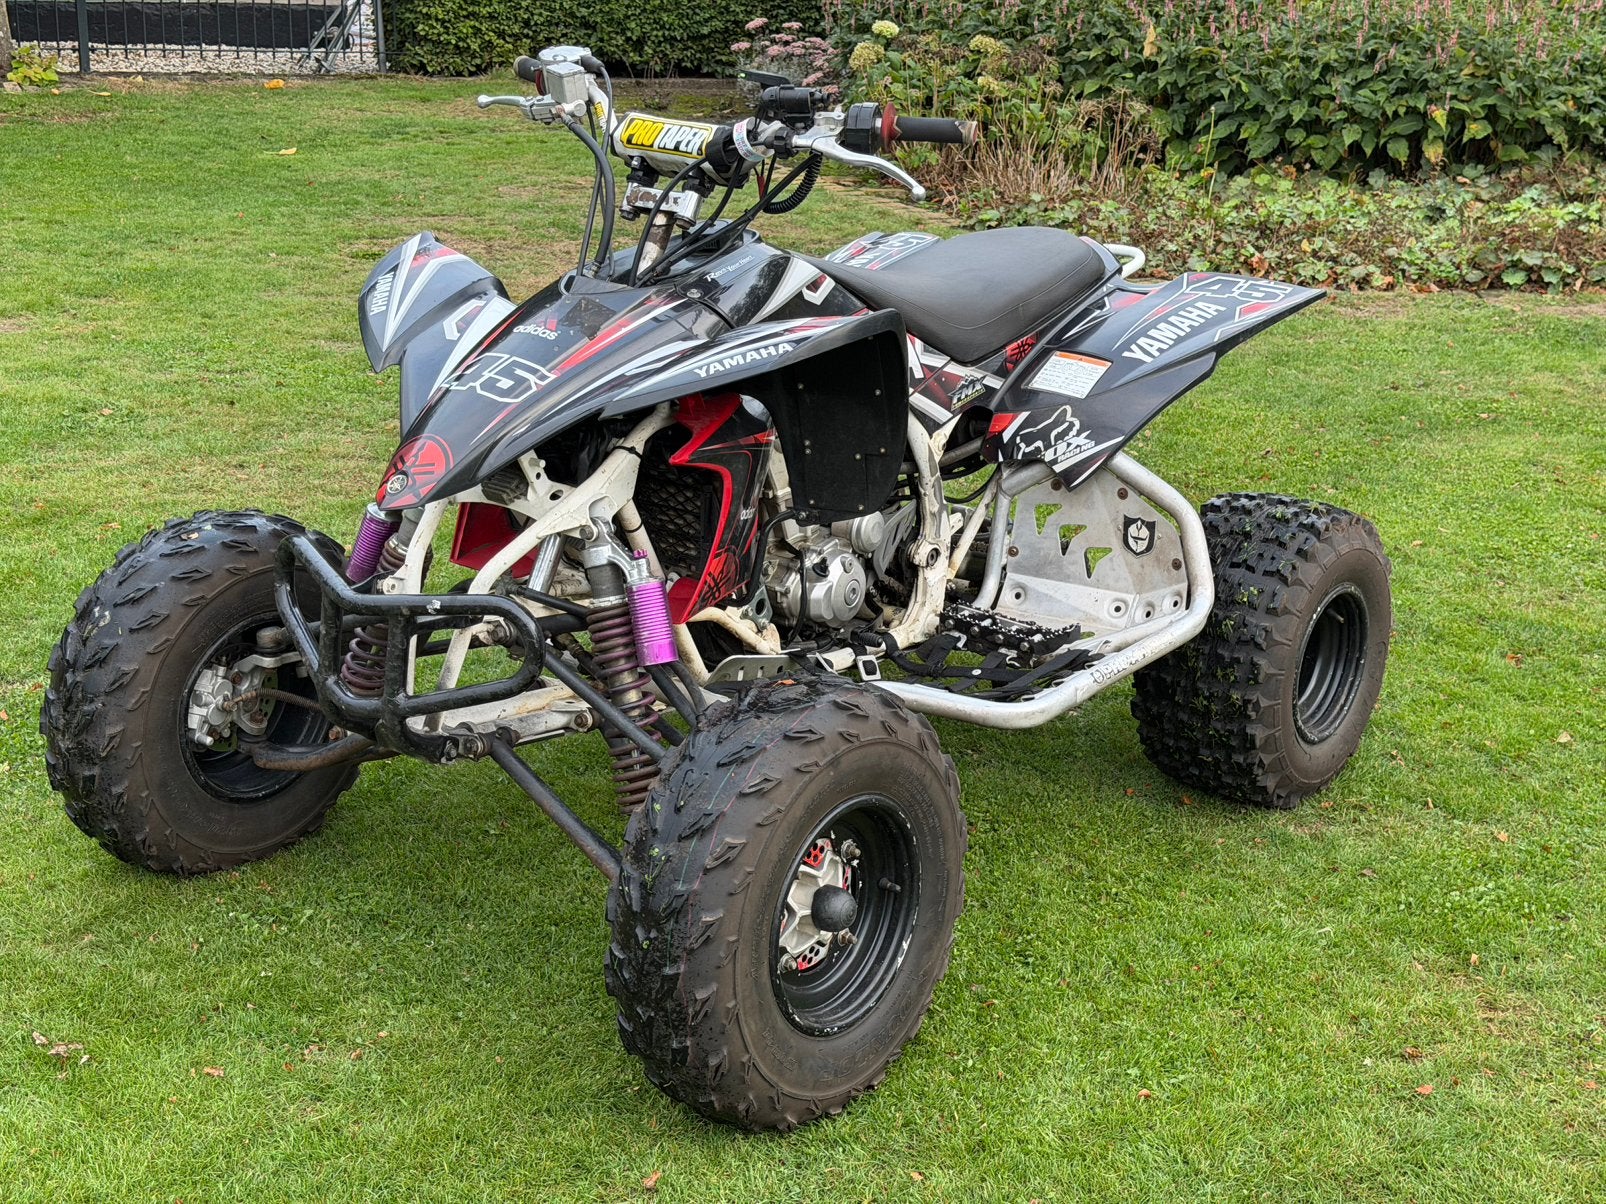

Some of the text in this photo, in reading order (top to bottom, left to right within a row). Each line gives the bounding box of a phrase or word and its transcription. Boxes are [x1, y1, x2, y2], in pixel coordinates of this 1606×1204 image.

[370, 271, 395, 316] YAMAHA
[513, 323, 559, 341] adidas
[1121, 301, 1228, 363] YAMAHA
[439, 352, 558, 403] 45
[693, 342, 795, 378] YAMAHA
